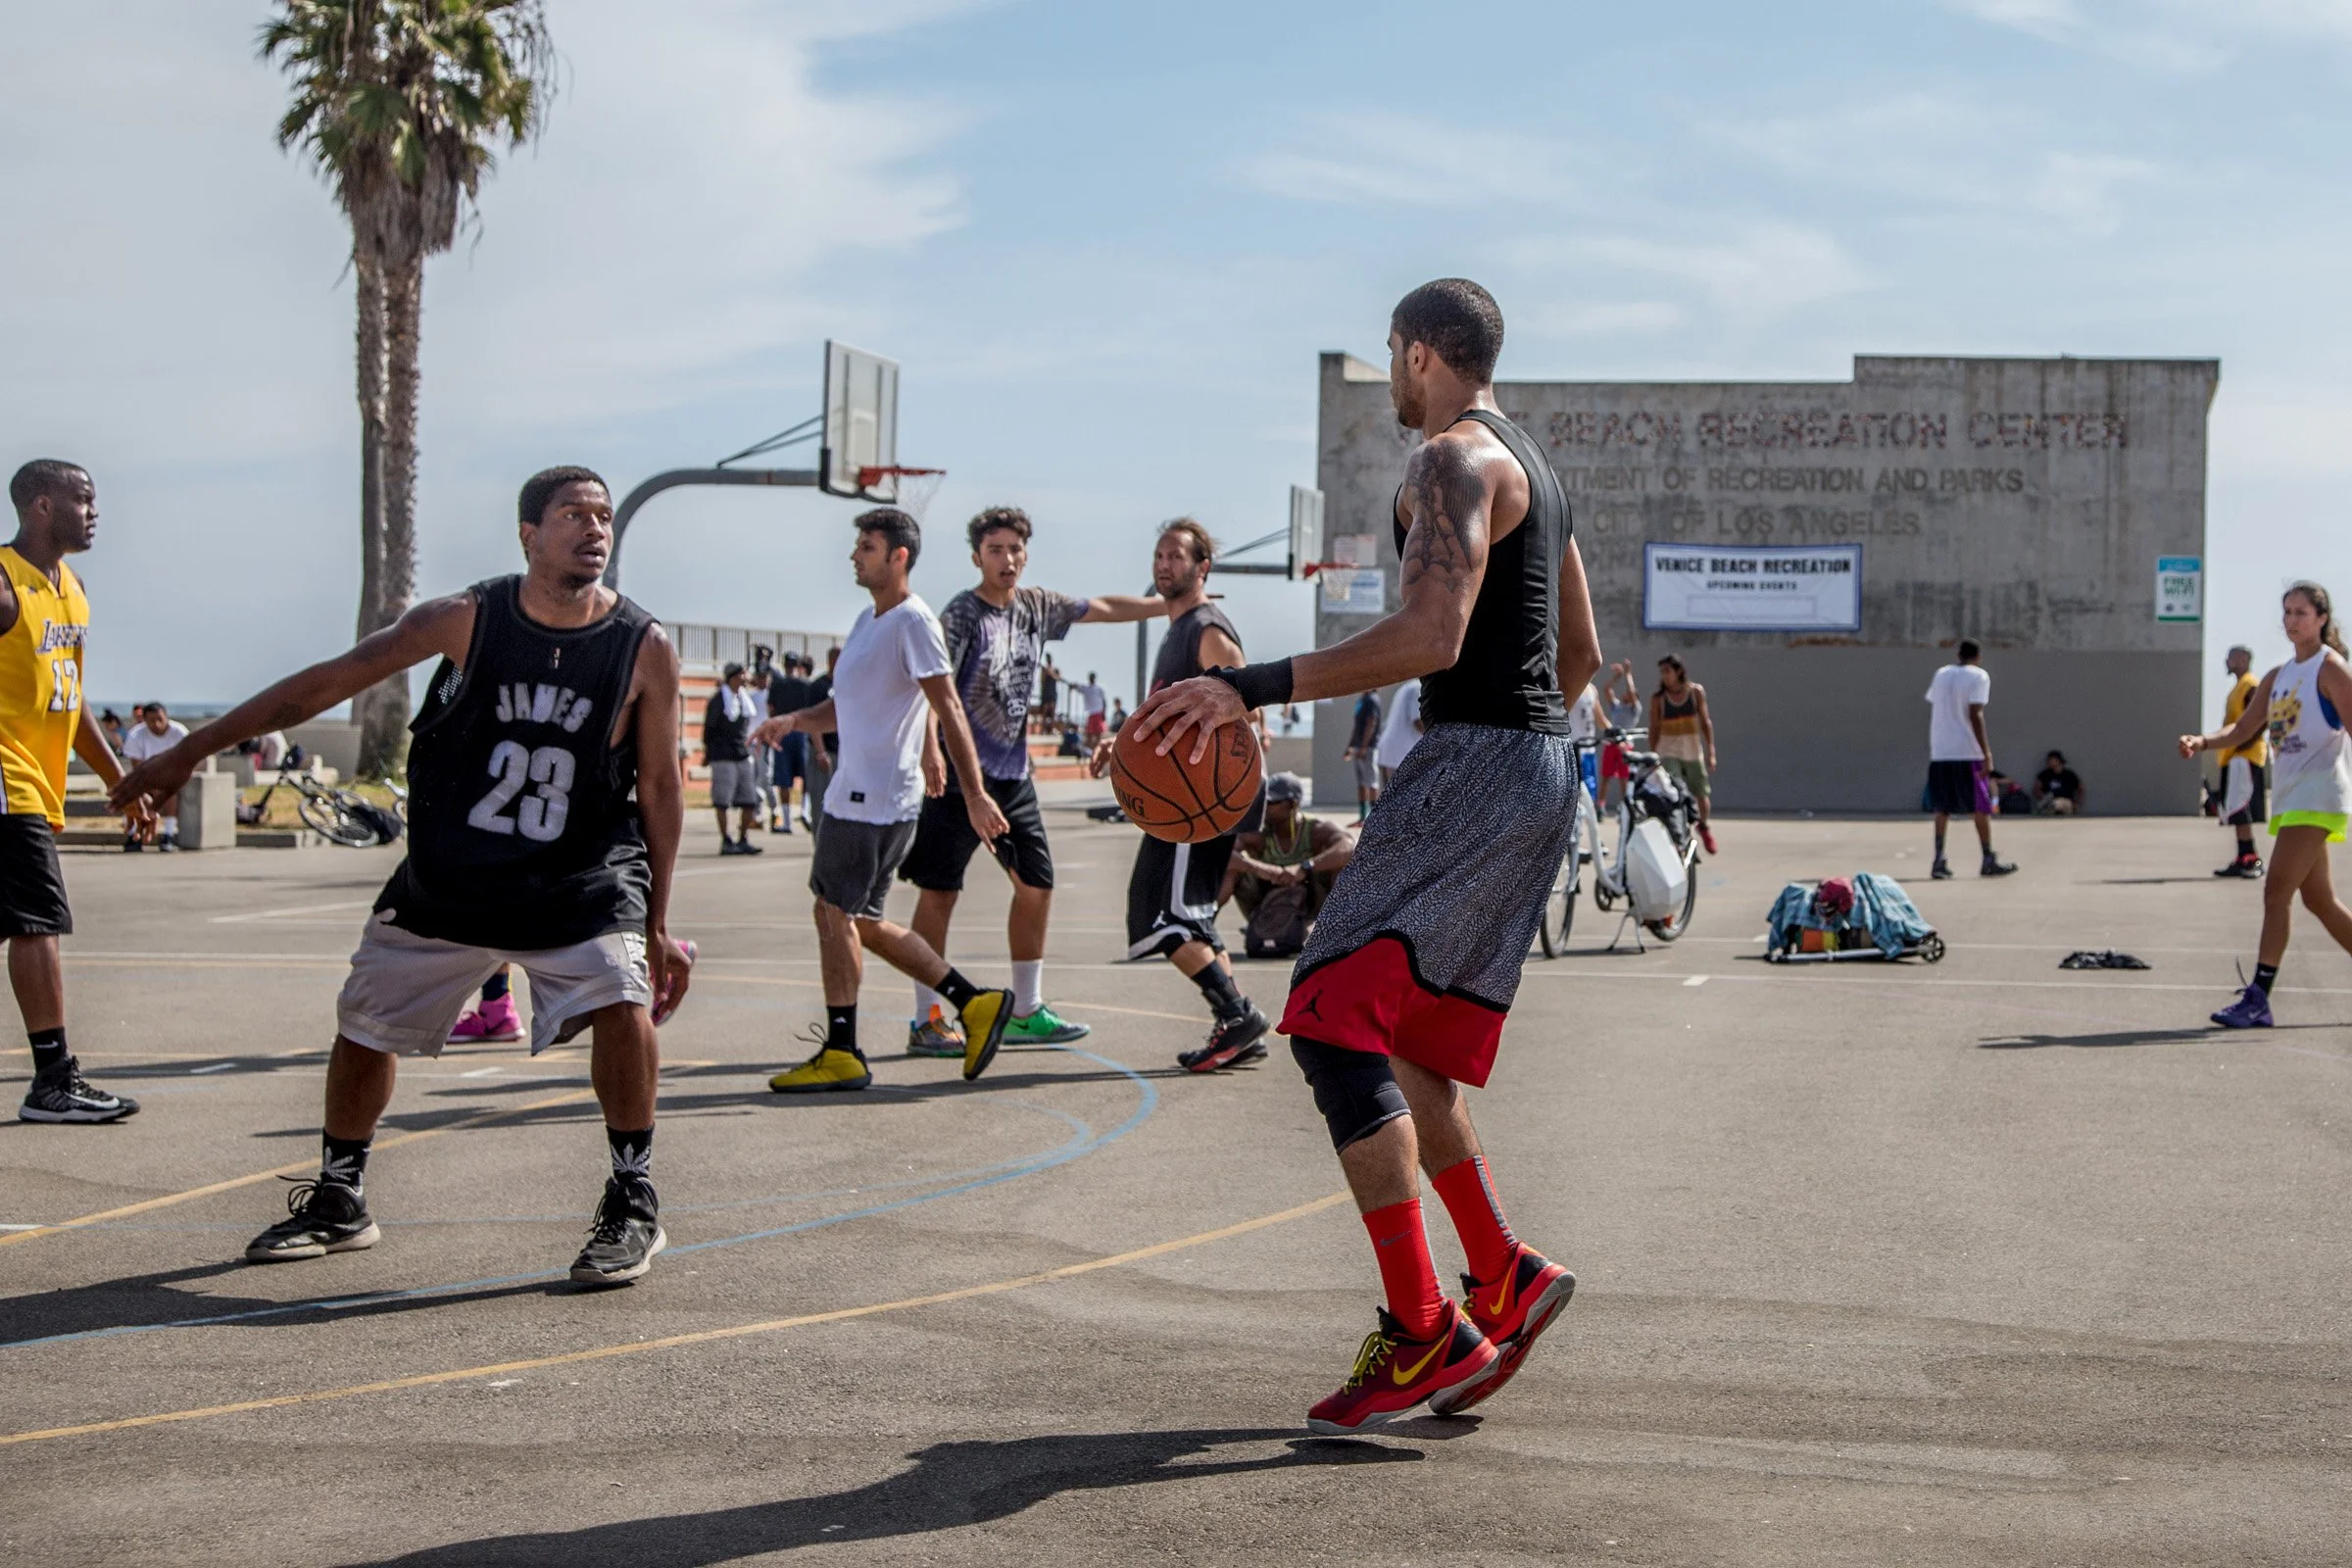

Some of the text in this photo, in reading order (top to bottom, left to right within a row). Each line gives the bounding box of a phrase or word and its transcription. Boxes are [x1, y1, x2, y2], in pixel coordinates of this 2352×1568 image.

[1549, 412, 1682, 447] BEACH
[1698, 412, 1948, 449] RECREATION
[1968, 412, 2130, 450] CENTER
[1559, 466, 2024, 492] TMENT OF RECREATION AND PARKS
[1593, 510, 1921, 536] CITY OF LOS ANGELES
[1655, 557, 1851, 573] VENICE BEACH RECREATION
[1760, 580, 1798, 590] EVENTS
[2164, 576, 2195, 585] FREE
[49, 658, 79, 712] 12
[495, 682, 593, 732] JAMES
[466, 740, 575, 842] 23
